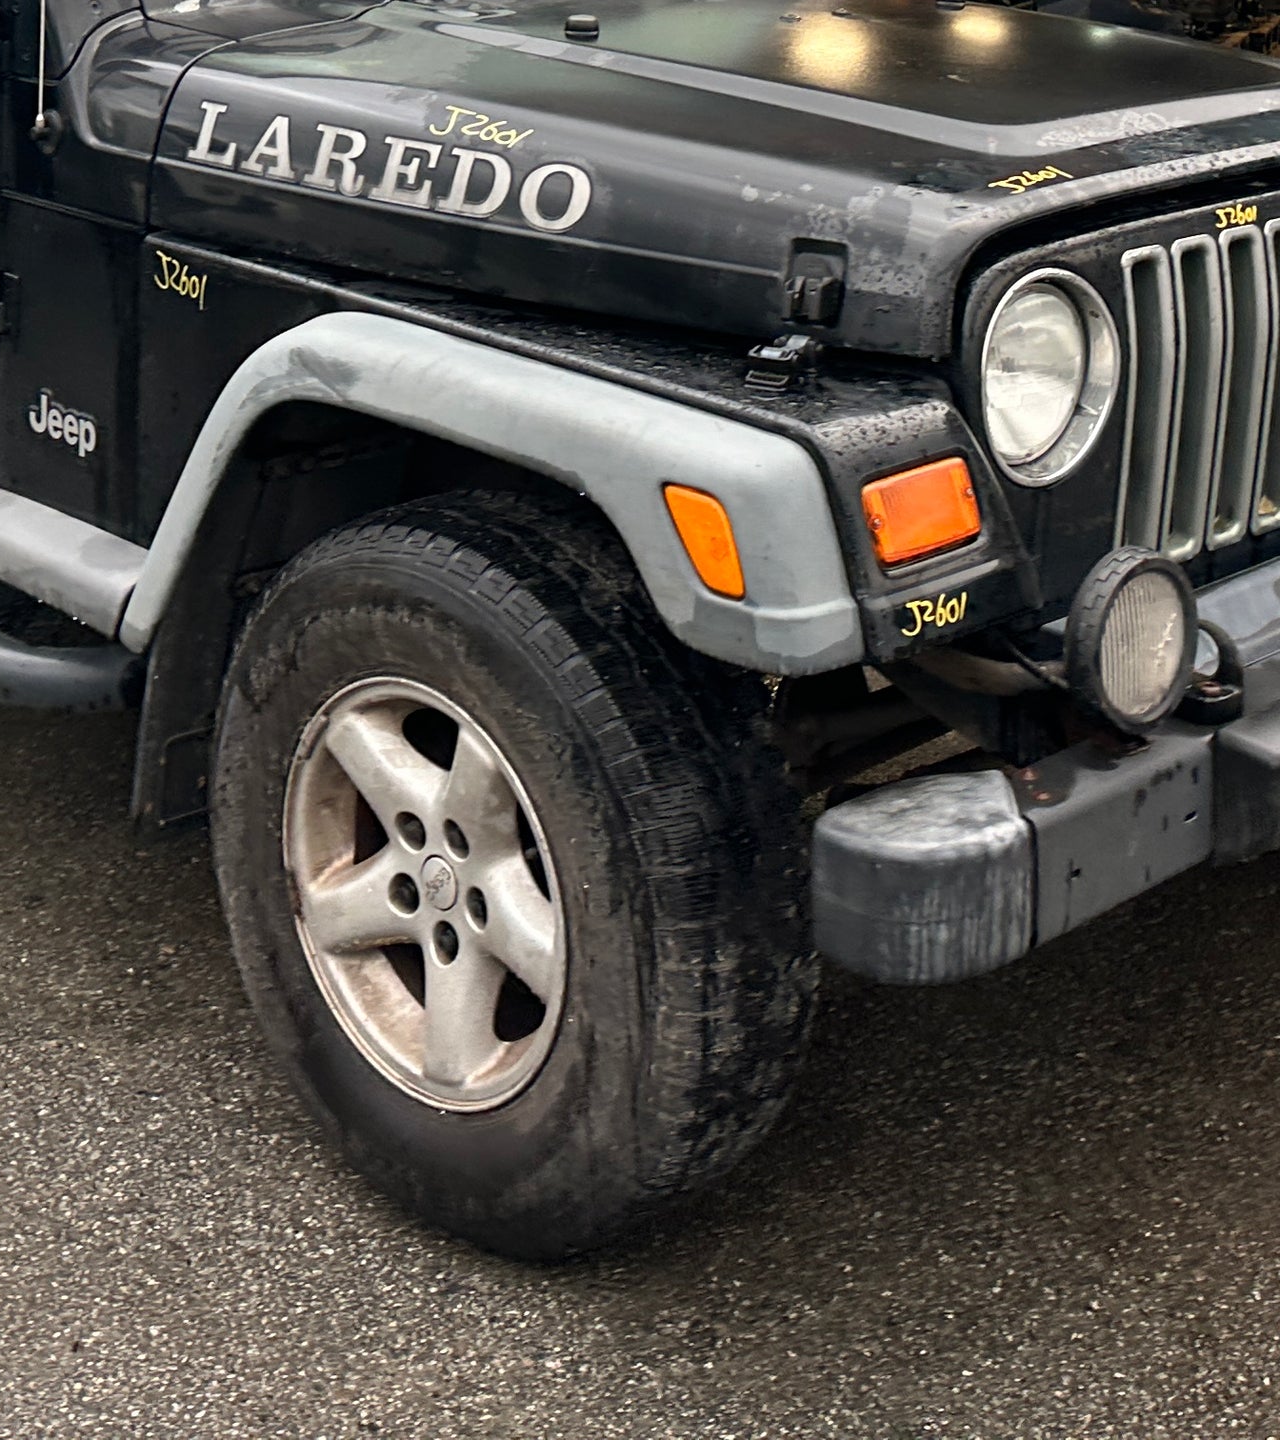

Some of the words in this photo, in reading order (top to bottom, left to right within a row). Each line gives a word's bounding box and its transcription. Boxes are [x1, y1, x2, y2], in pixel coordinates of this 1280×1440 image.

[429, 105, 536, 148] J2601
[187, 100, 593, 234] LAREDO
[988, 165, 1074, 195] J2601
[1215, 203, 1258, 229] J2601
[154, 250, 208, 310] J2601
[28, 388, 98, 458] Jeep
[901, 591, 968, 637] J2601
